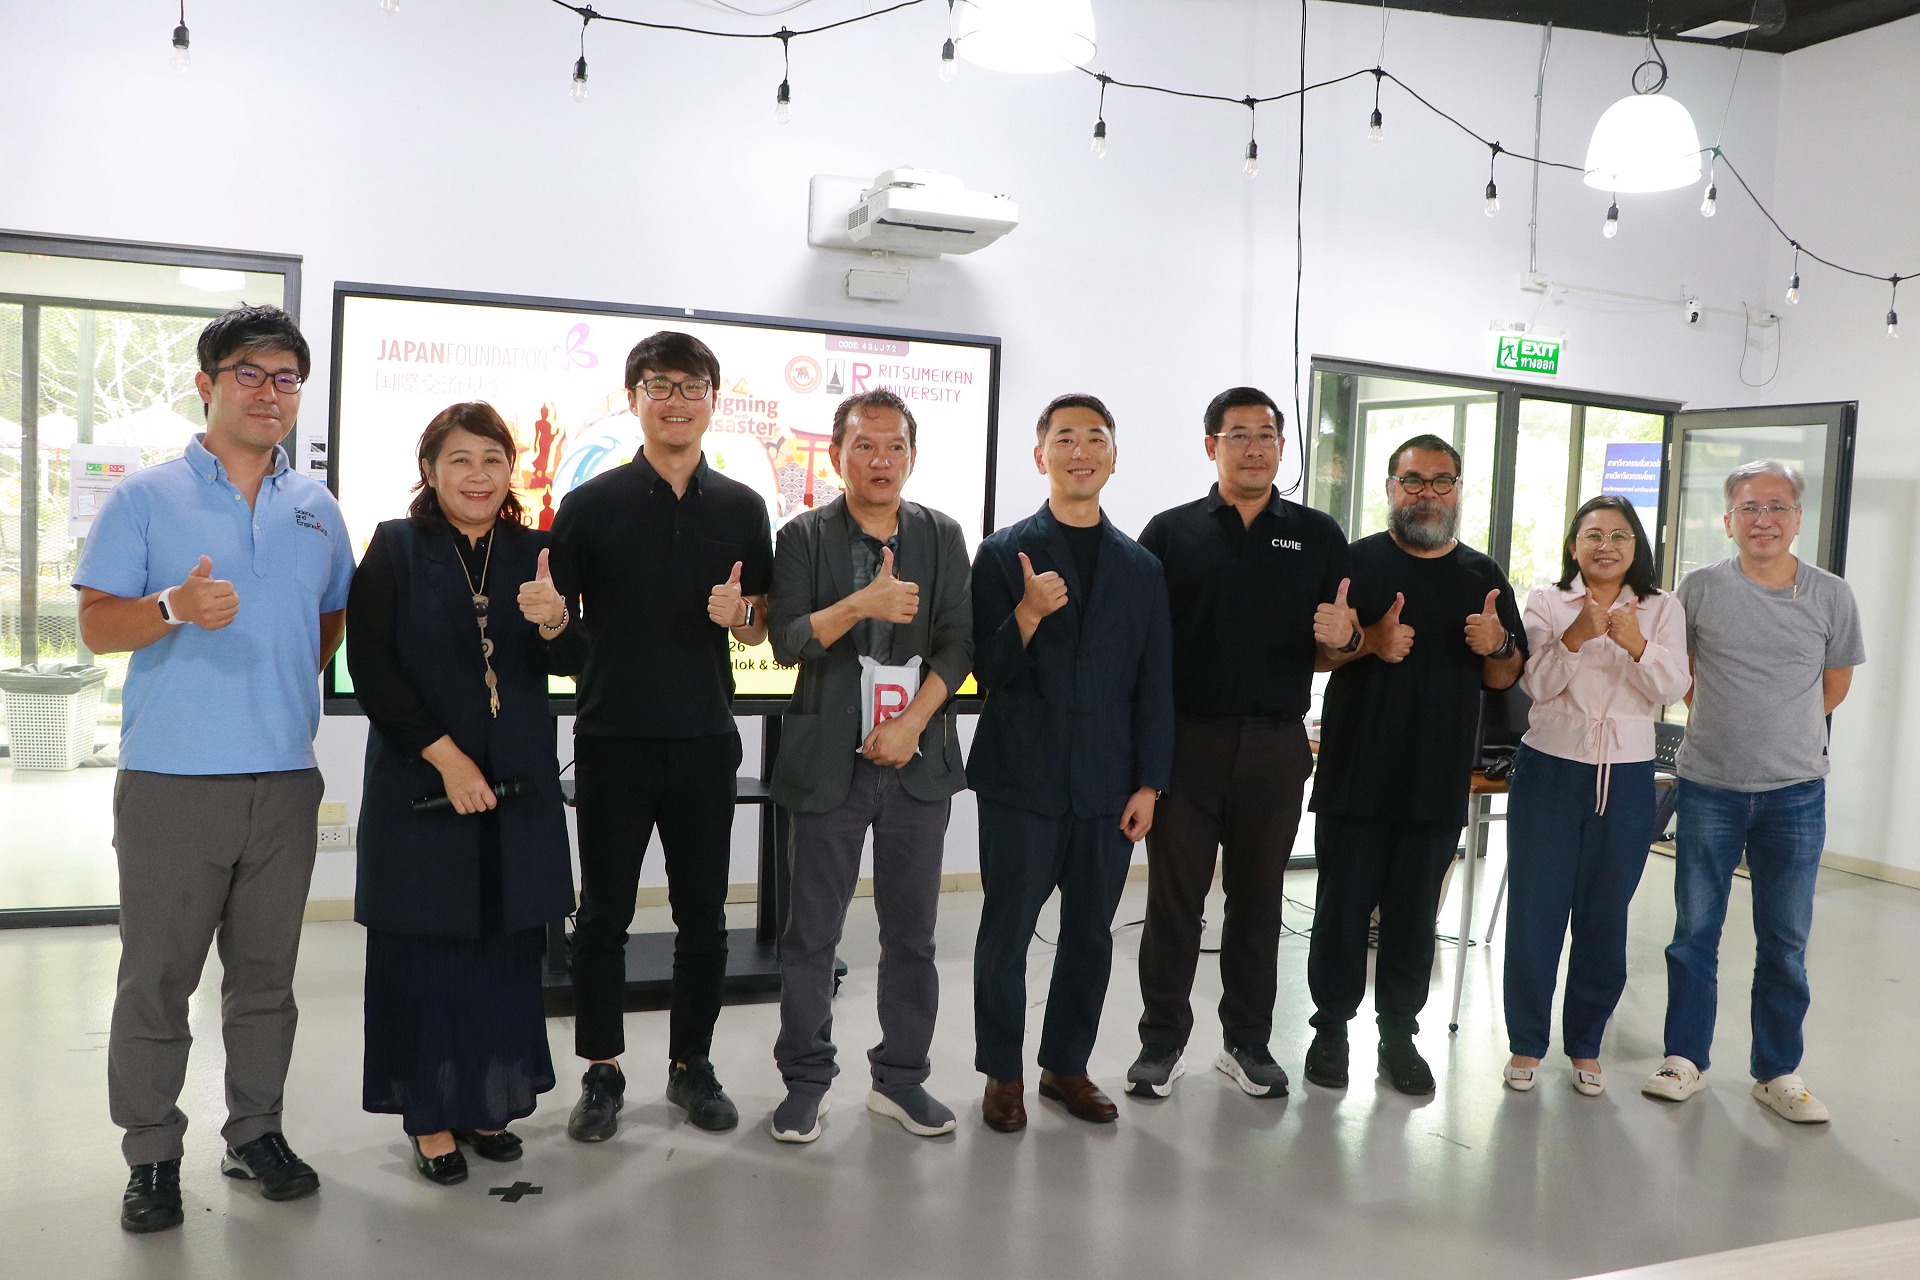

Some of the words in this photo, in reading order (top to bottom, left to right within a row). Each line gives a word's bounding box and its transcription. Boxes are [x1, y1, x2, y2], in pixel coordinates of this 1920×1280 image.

[838, 340, 860, 349] CODE:
[1521, 341, 1558, 358] EXIT
[1520, 357, 1555, 371] ทางออก
[878, 364, 973, 385] RITSUMEIKAN
[717, 392, 779, 419] igning
[1271, 538, 1302, 551] CWIE
[759, 659, 768, 670] &
